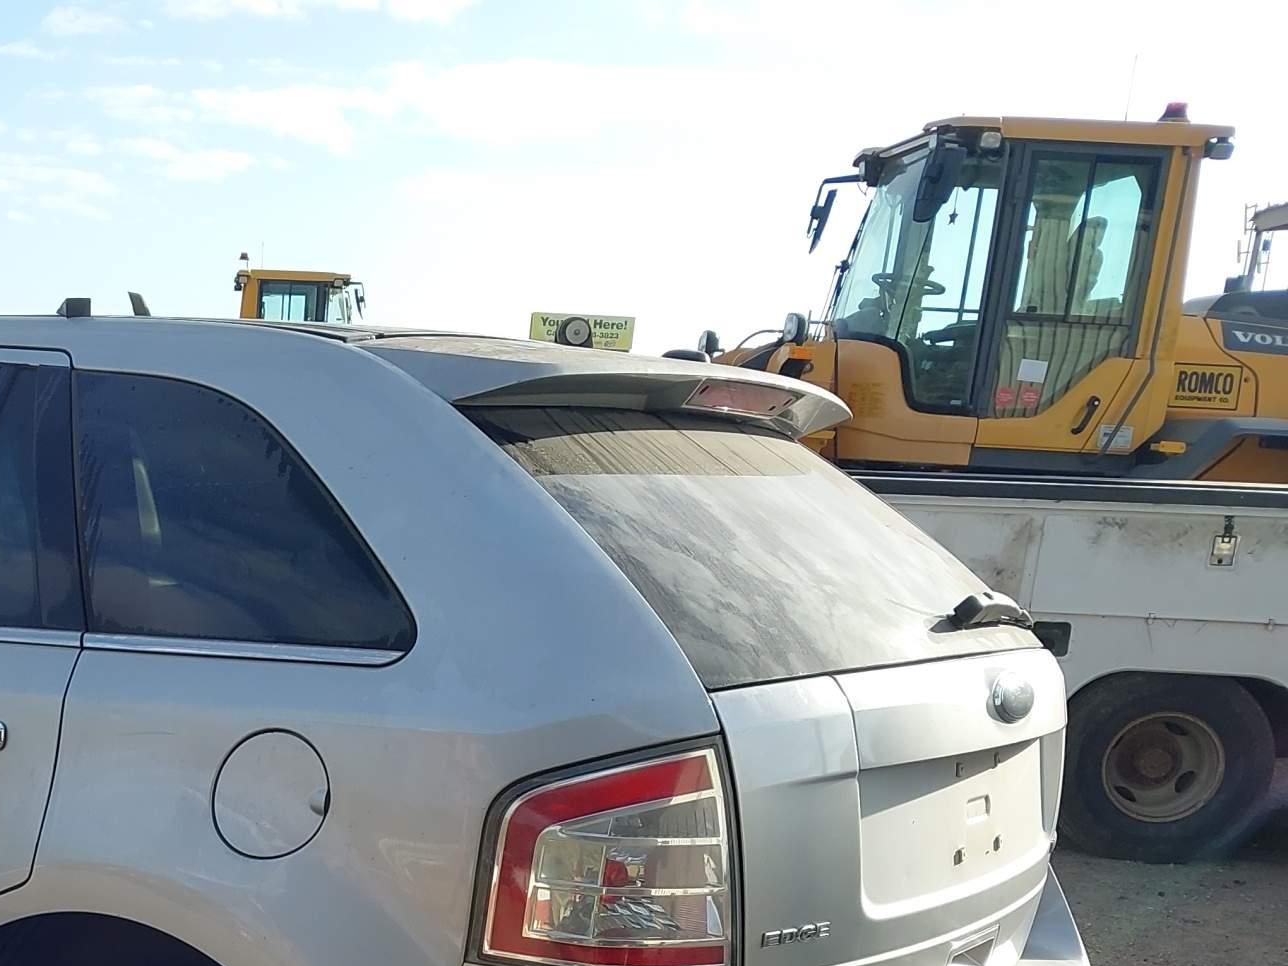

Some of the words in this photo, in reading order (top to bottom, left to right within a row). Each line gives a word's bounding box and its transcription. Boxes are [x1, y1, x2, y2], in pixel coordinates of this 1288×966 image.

[593, 319, 628, 330] Here!
[1232, 330, 1288, 347] VOL
[1176, 370, 1234, 395] ROMCO
[760, 920, 832, 949] EDGE
